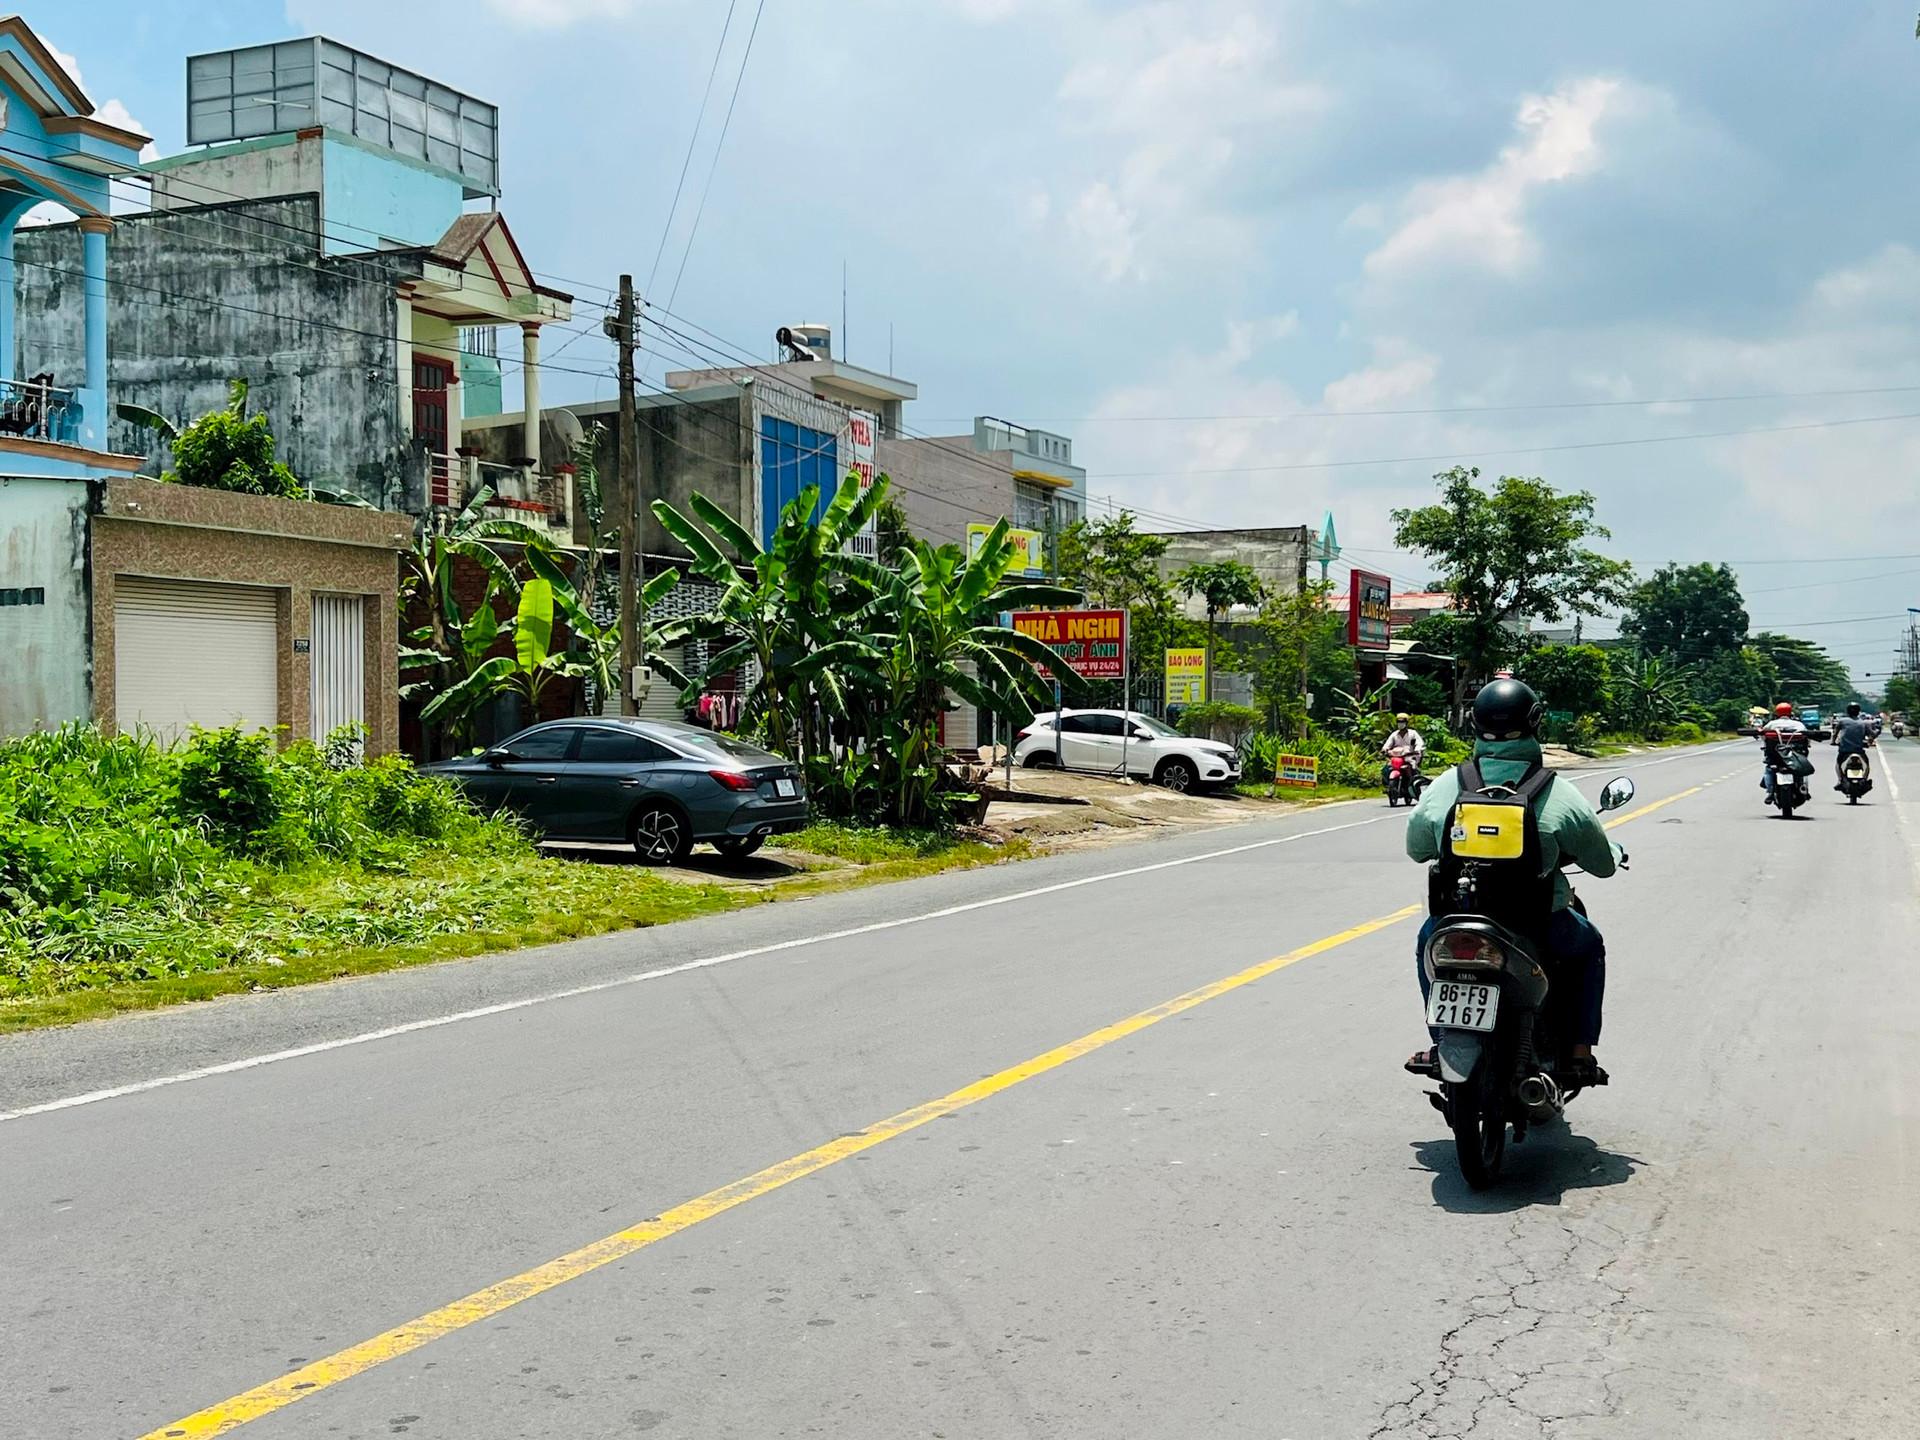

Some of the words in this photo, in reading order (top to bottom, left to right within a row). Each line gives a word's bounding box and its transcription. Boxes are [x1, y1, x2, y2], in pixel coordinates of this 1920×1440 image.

[1015, 615, 1060, 640] NHÀ
[1090, 640, 1119, 658] ÁNH
[1099, 661, 1119, 670] 24/24
[1184, 655, 1203, 667] LONG
[1439, 983, 1489, 1006] 86-F9
[1435, 1004, 1487, 1027] 2167
